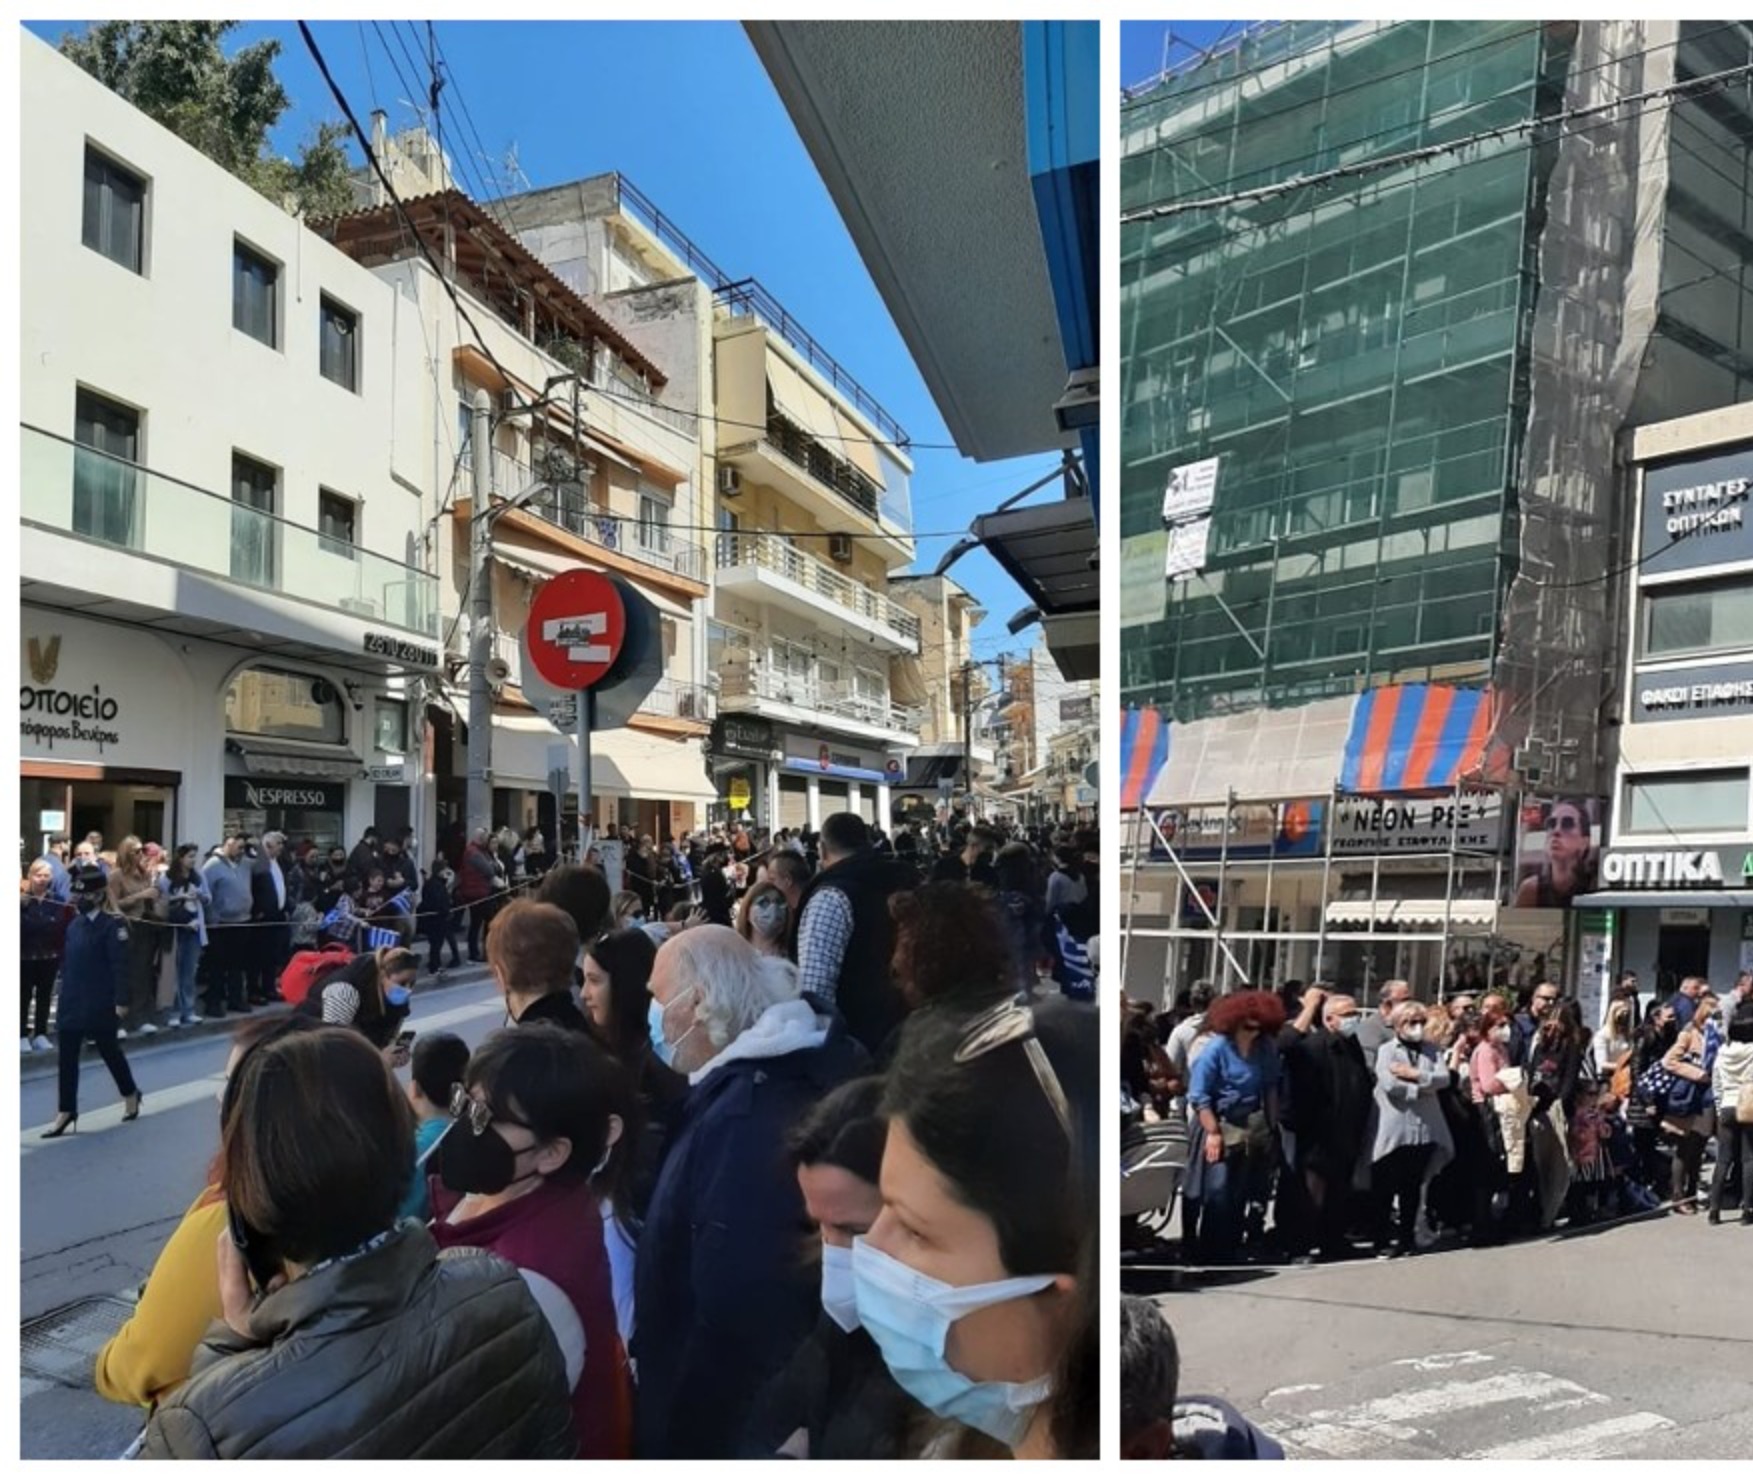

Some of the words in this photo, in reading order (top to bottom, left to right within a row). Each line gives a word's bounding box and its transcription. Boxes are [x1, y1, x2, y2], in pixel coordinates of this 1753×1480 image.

[1663, 478, 1749, 508] ΣΥΝΤΑΓΕΣ
[241, 780, 326, 808] NESPRESSO
[1399, 834, 1489, 847] ΣΤΑΦΥΛΚΗΣ
[1602, 851, 1723, 882] ΟΠΤΙΚΑ
